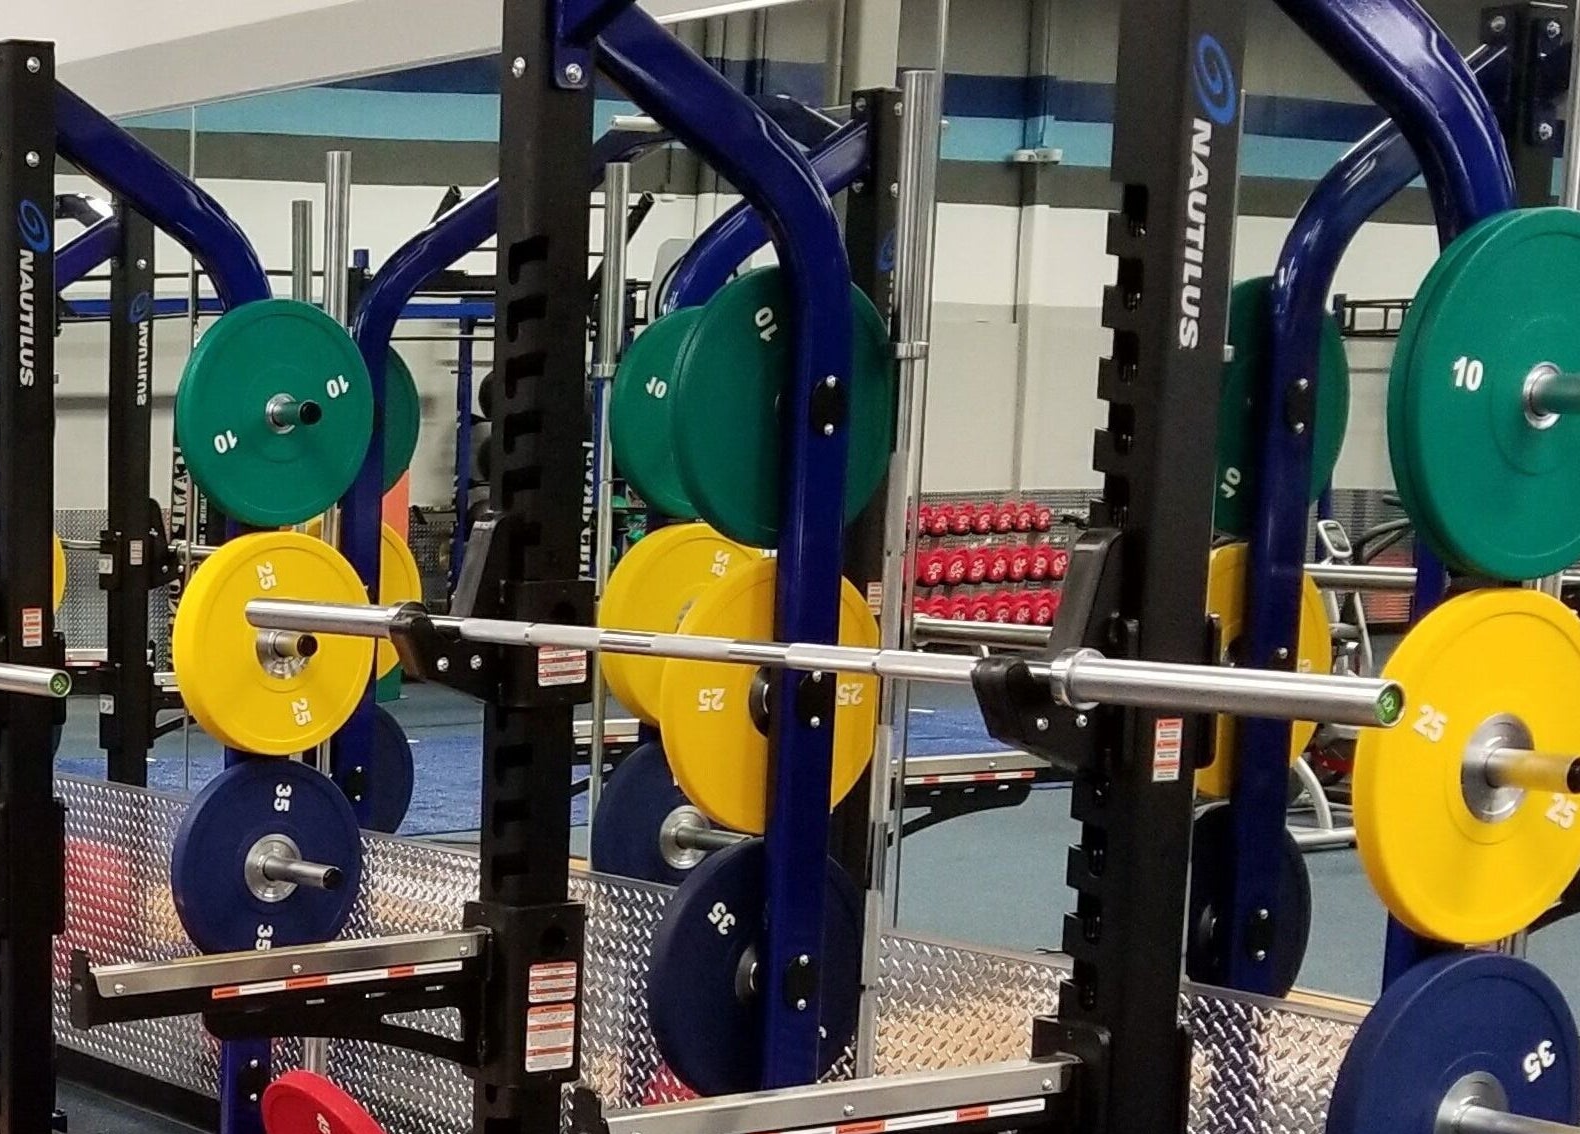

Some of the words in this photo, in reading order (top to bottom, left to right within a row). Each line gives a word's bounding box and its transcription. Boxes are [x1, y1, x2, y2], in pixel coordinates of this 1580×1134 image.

[1177, 117, 1213, 351] NAUTILUS
[19, 248, 35, 388] NAUTILUS
[754, 306, 778, 342] 10
[326, 375, 349, 399] 10
[1452, 356, 1484, 392] 10
[214, 430, 238, 454] 10
[256, 561, 277, 590] 25
[698, 687, 725, 712] 25
[836, 682, 864, 708] 25
[291, 697, 313, 726] 25
[1412, 704, 1448, 742] 25
[273, 783, 293, 812] 35
[1545, 792, 1579, 829] 25
[707, 902, 736, 935] 35
[254, 923, 274, 952] 35
[1522, 1040, 1556, 1083] 35
